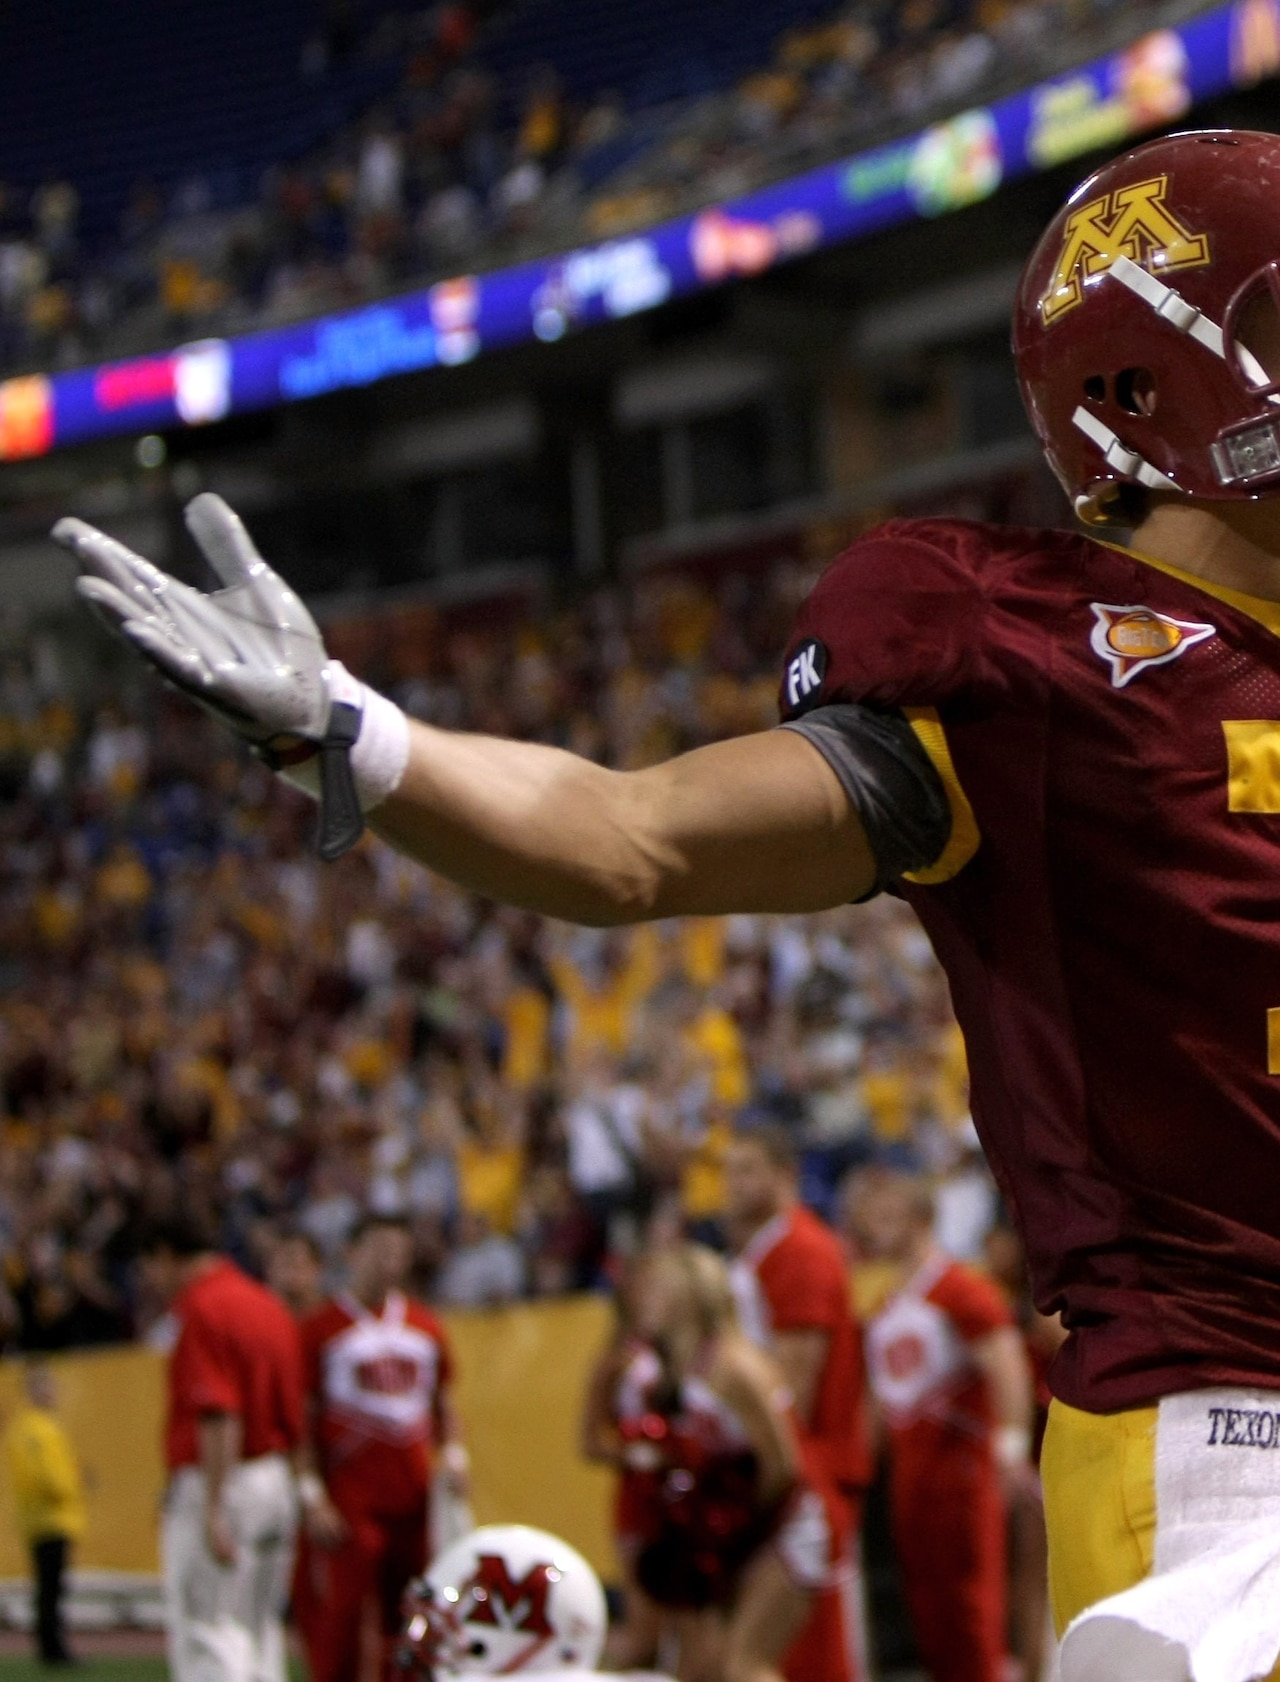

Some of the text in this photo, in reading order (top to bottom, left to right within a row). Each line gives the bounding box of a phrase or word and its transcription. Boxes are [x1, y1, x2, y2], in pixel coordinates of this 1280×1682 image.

[1042, 176, 1210, 326] M
[787, 644, 821, 706] FK
[463, 1553, 556, 1637] M
